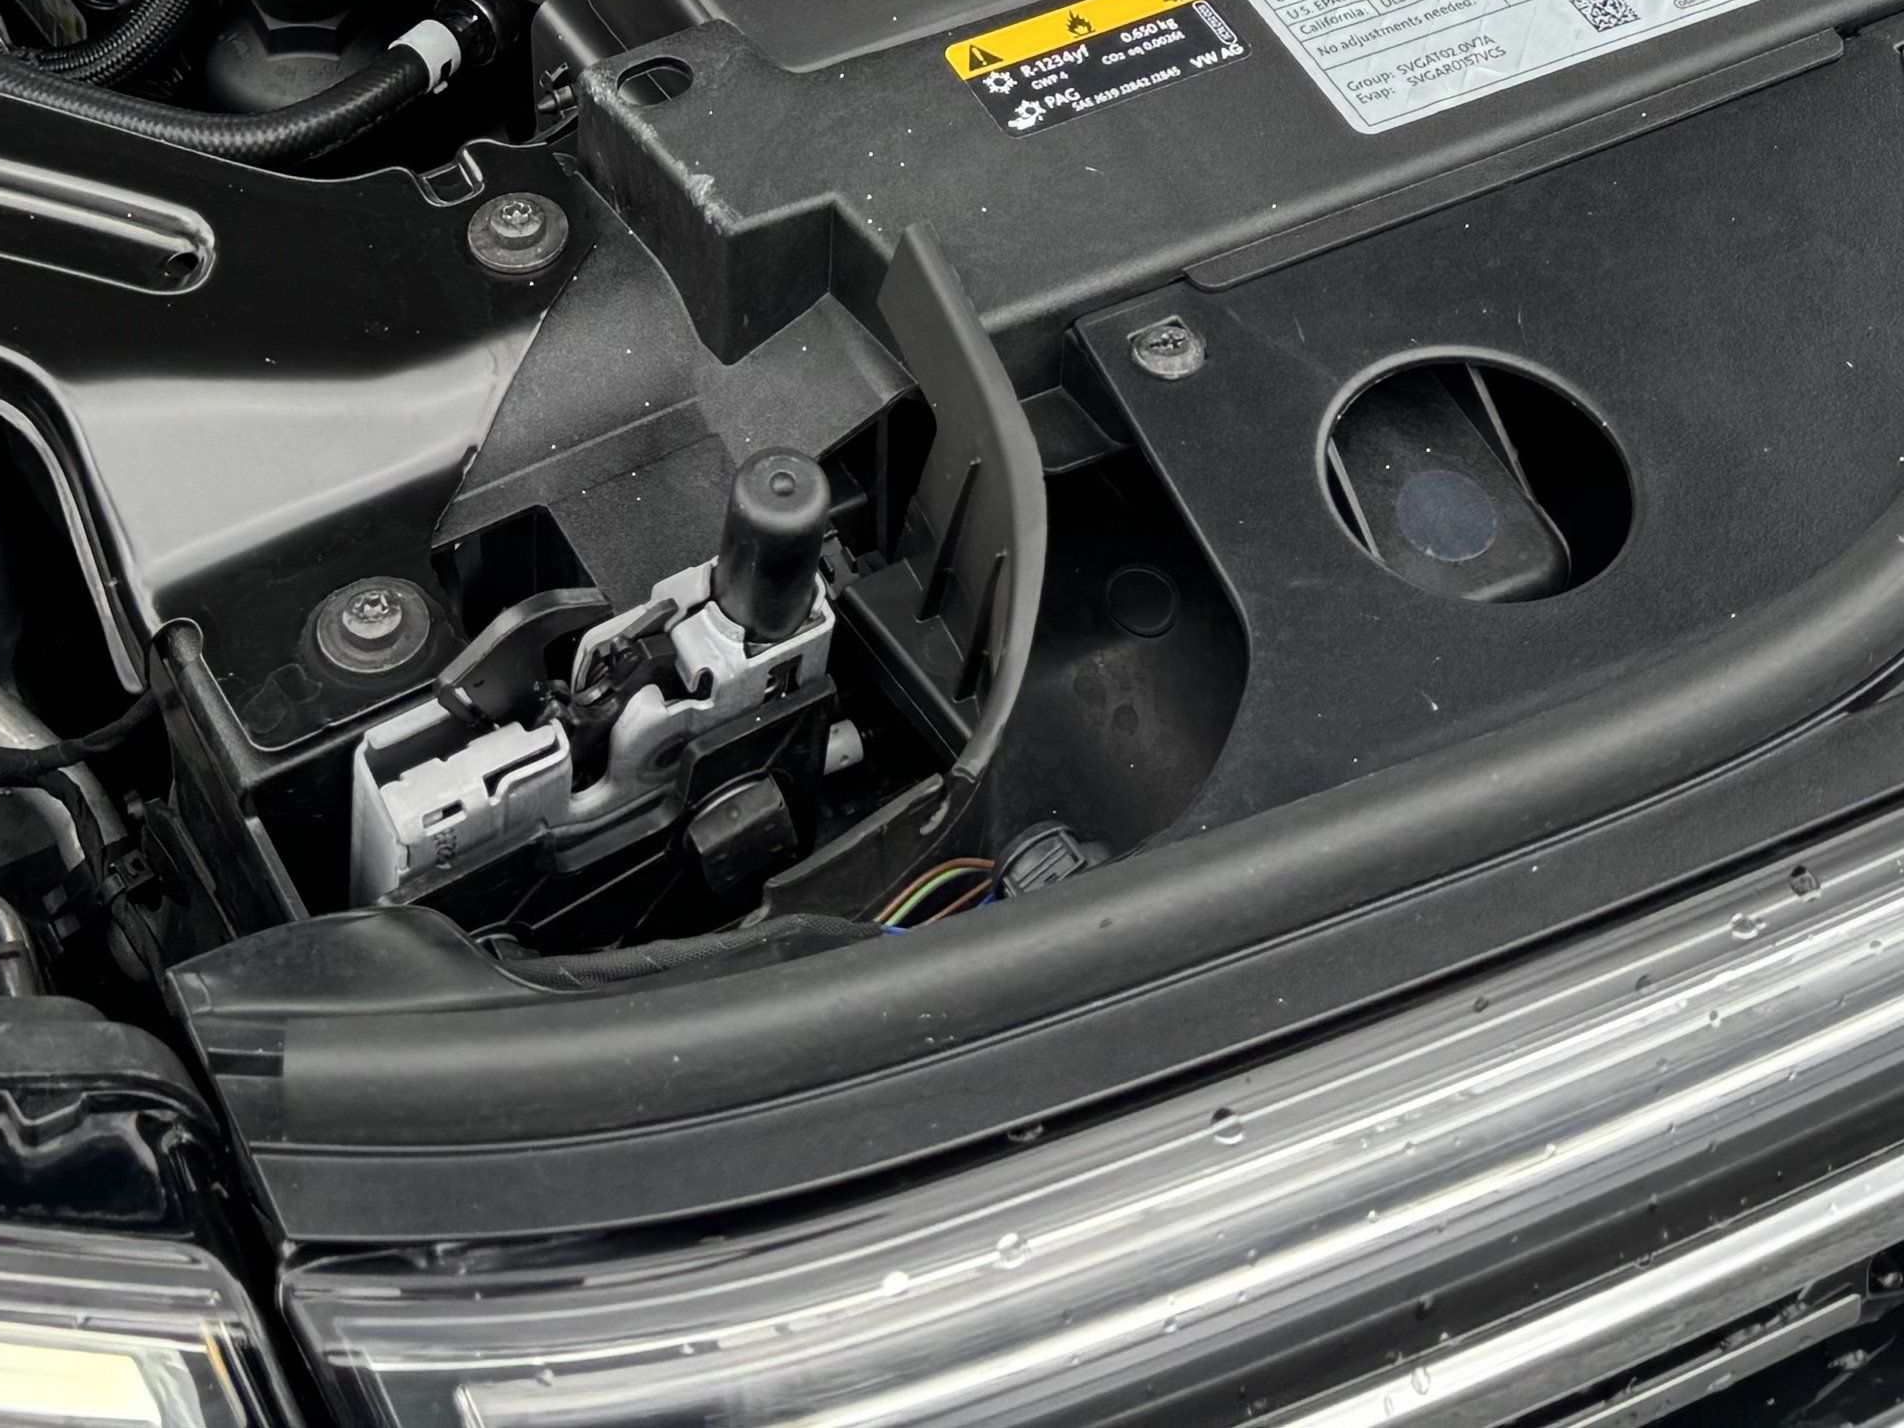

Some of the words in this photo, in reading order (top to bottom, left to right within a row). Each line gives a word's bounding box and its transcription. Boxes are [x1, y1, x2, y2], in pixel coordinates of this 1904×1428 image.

[1299, 8, 1369, 35] California:
[1019, 44, 1089, 78] R-1234yf
[1120, 23, 1158, 43] 0.650
[1156, 18, 1179, 31] kg
[1316, 44, 1339, 57] No
[1339, 16, 1423, 50] adjustments
[1190, 51, 1218, 69] VW
[1220, 43, 1244, 59] AG
[1059, 71, 1069, 80] 4
[1346, 71, 1396, 92] Group:
[1044, 87, 1081, 108] PAG
[1355, 87, 1396, 105] Evap:
